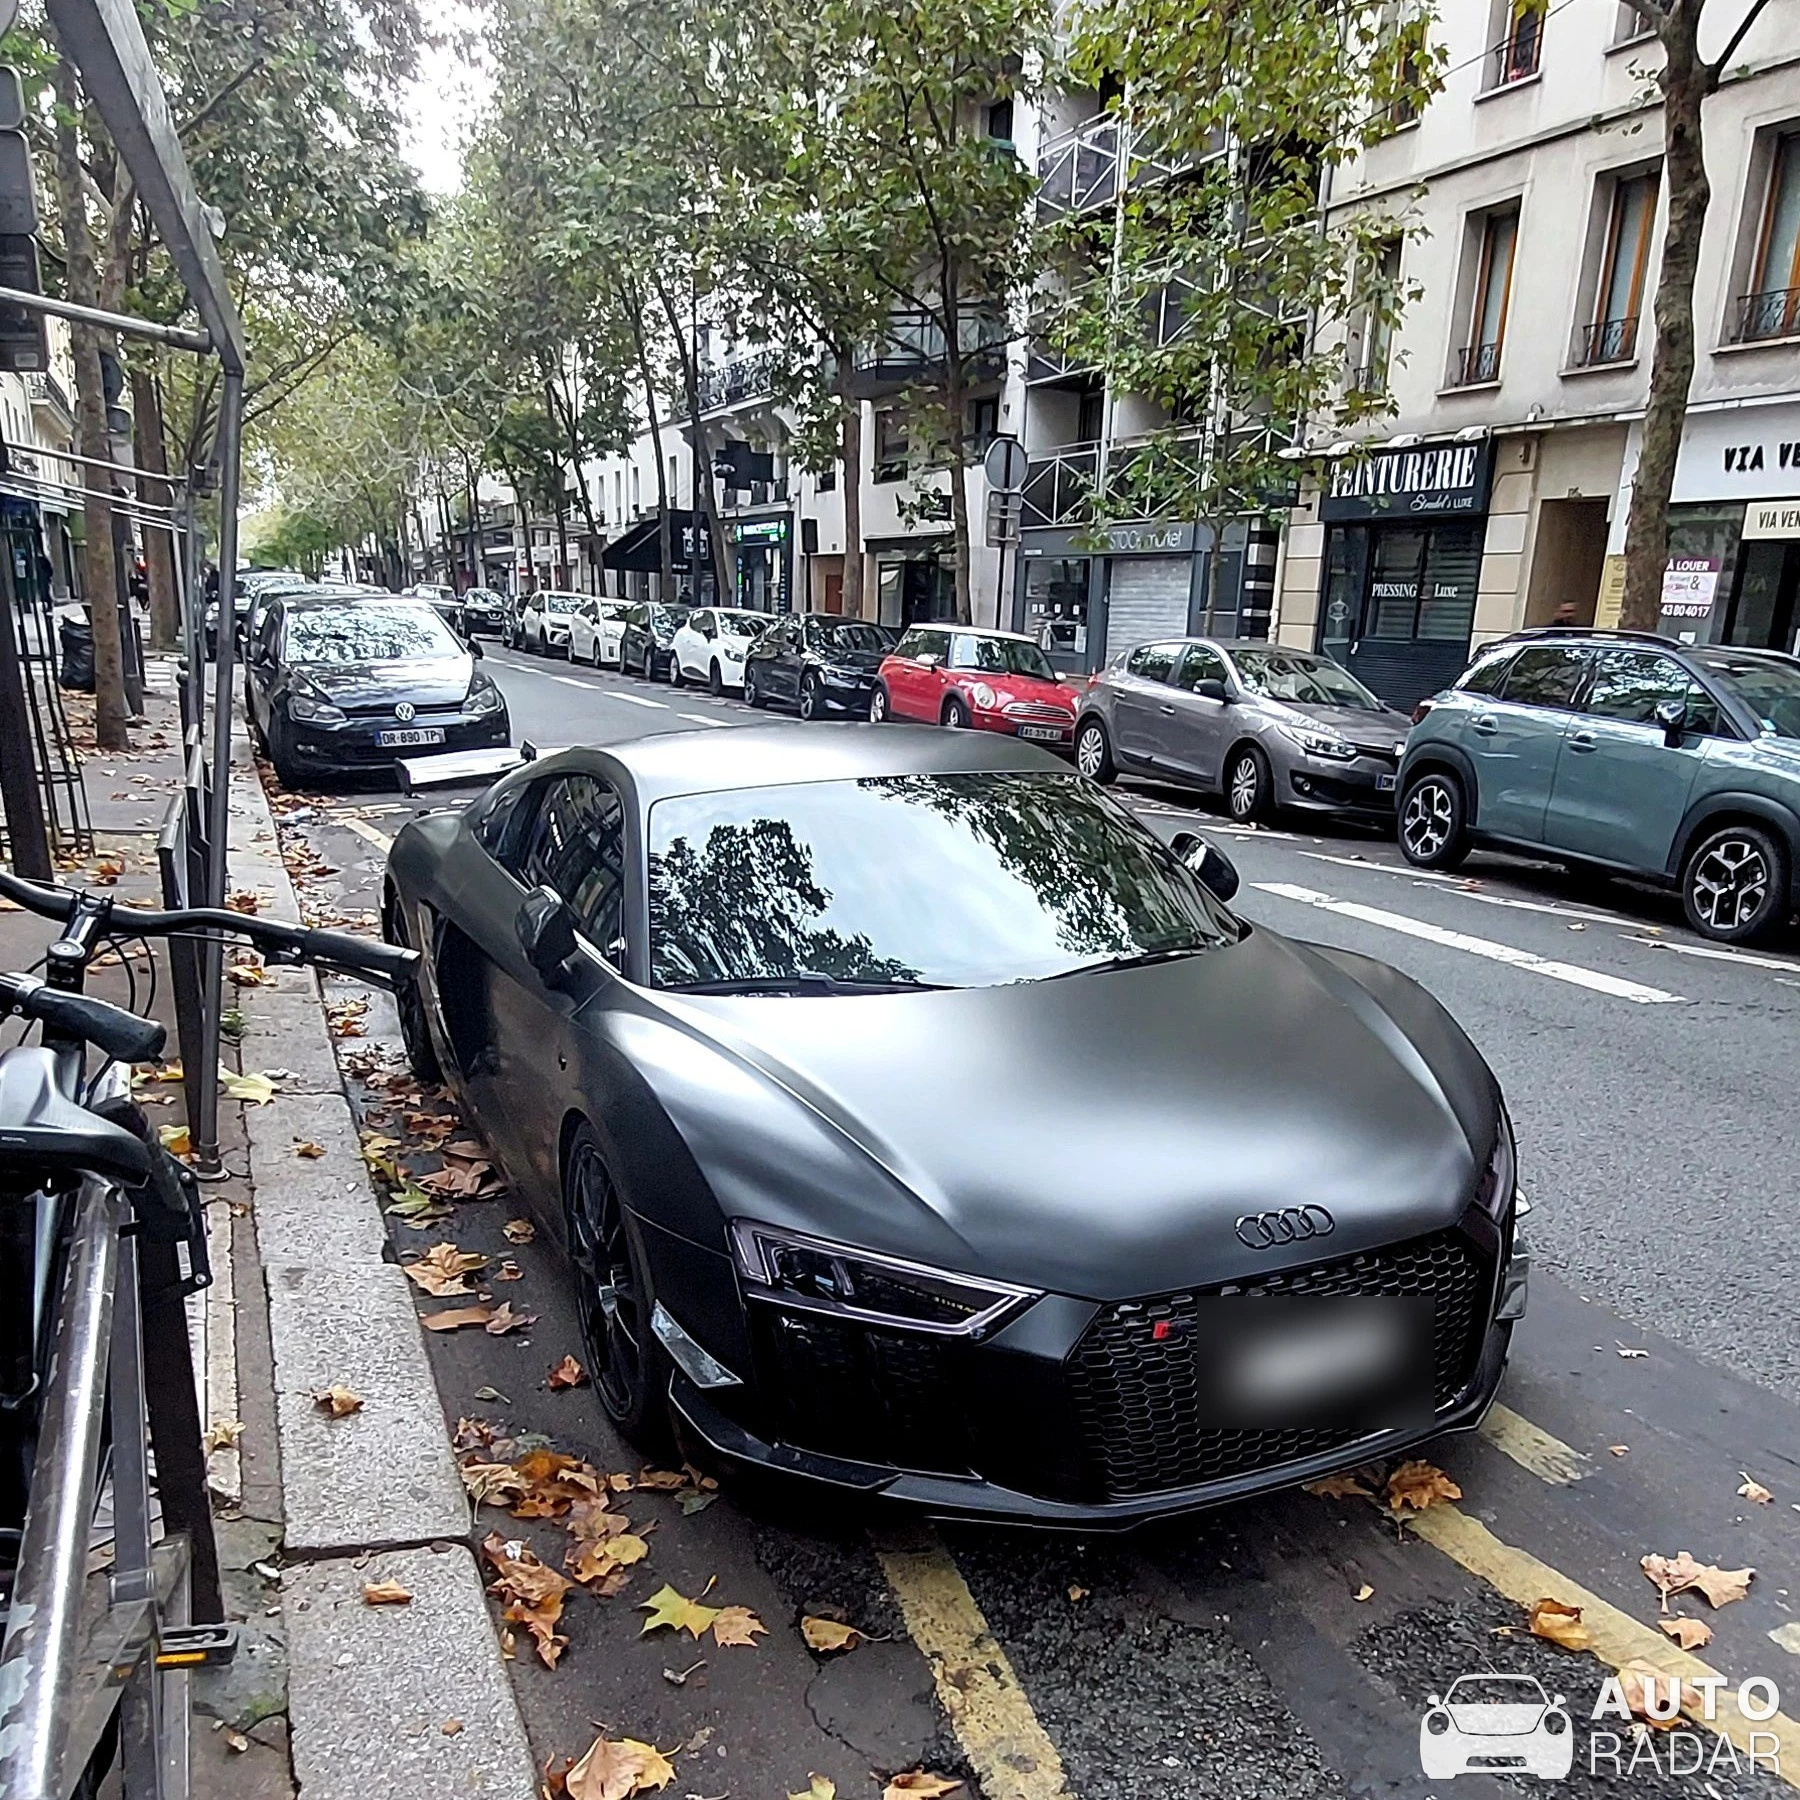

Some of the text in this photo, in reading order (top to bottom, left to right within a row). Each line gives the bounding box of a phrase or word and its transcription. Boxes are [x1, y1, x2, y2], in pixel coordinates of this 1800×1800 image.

[1724, 446, 1764, 471] VIA
[1330, 446, 1478, 498] TEINTURERIE
[1759, 511, 1777, 528] VIA
[1676, 560, 1710, 571] LOUER
[1372, 583, 1458, 598] PRESSING Luxe
